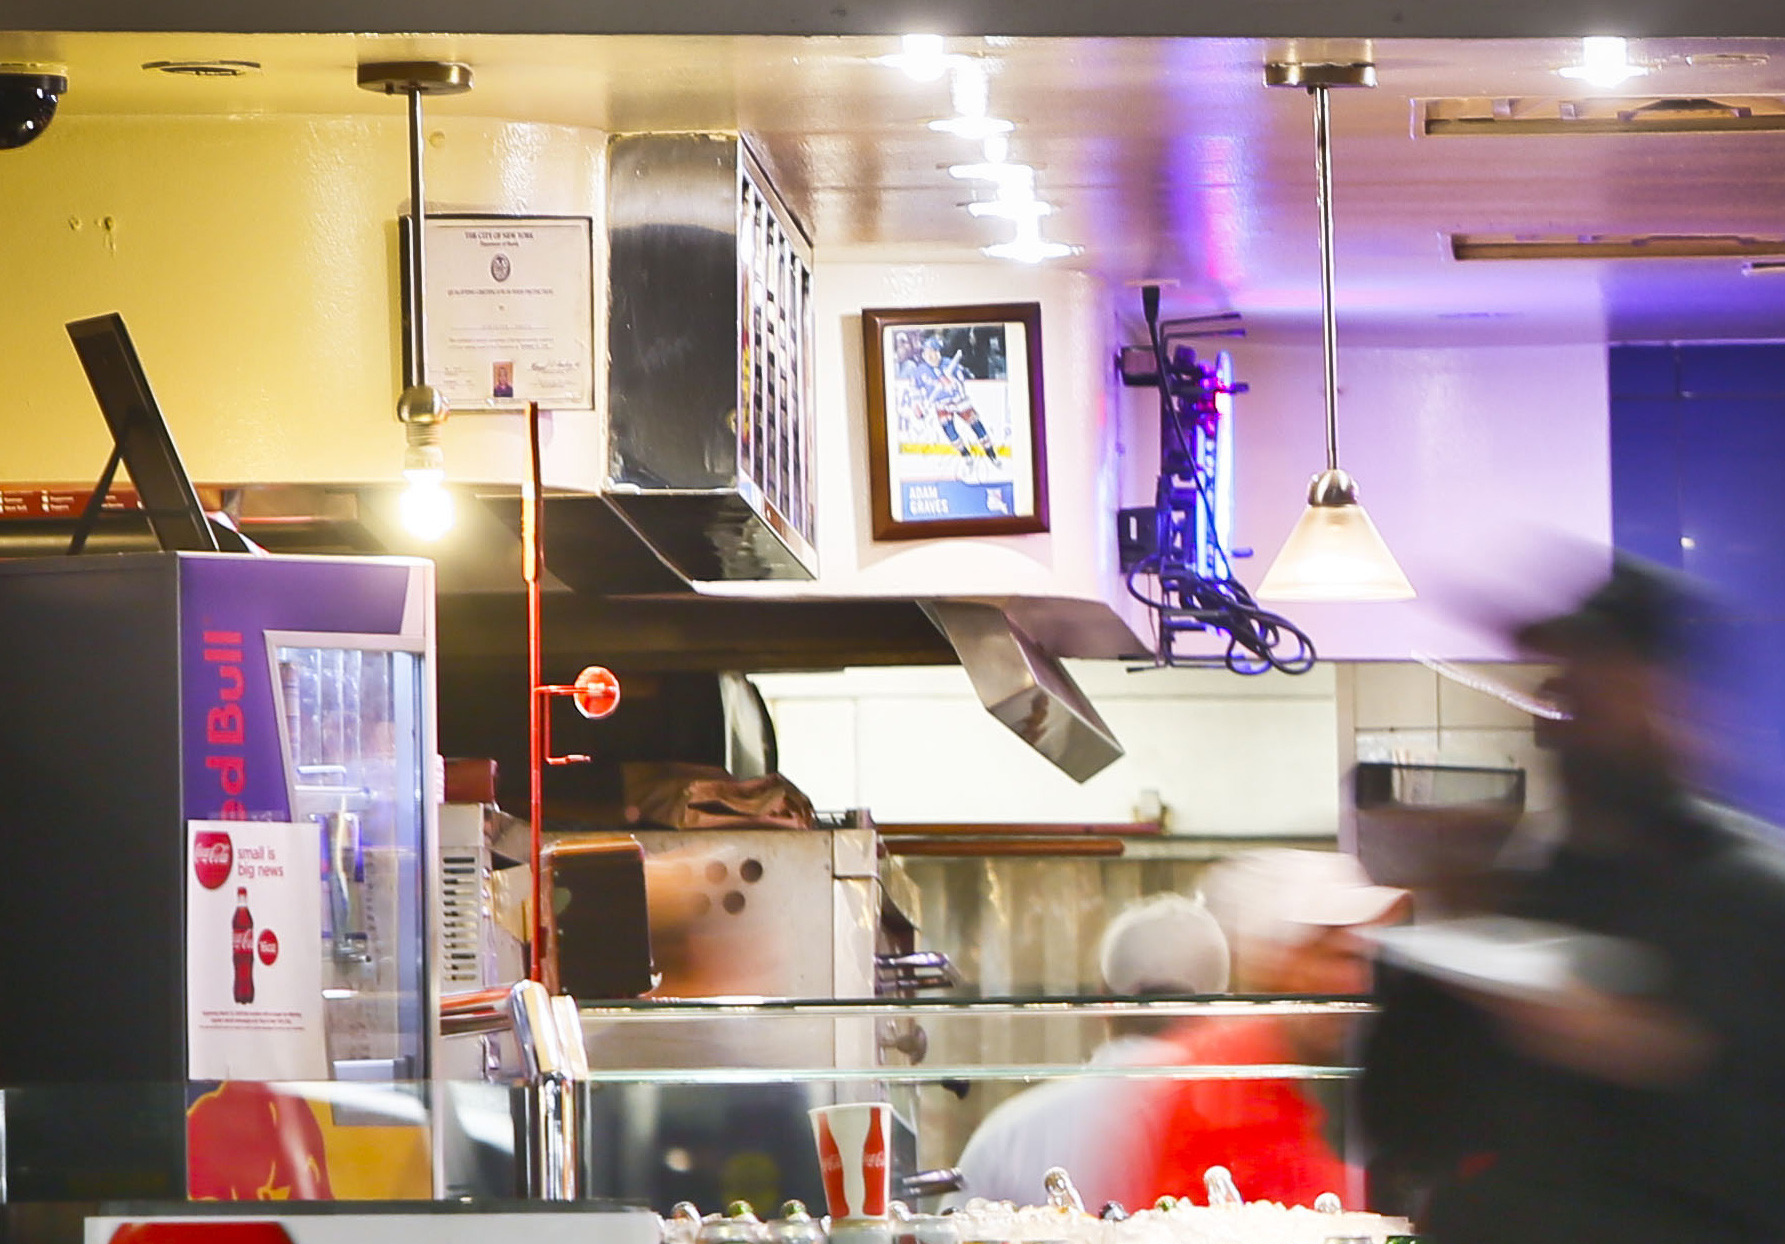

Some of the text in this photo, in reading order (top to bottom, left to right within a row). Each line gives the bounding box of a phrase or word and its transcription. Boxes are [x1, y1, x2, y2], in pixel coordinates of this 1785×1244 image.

[909, 485, 939, 499] ADAM
[909, 498, 950, 516] GRAVES
[202, 630, 247, 821] ed Bull
[237, 846, 275, 860] small is
[237, 862, 283, 879] big news
